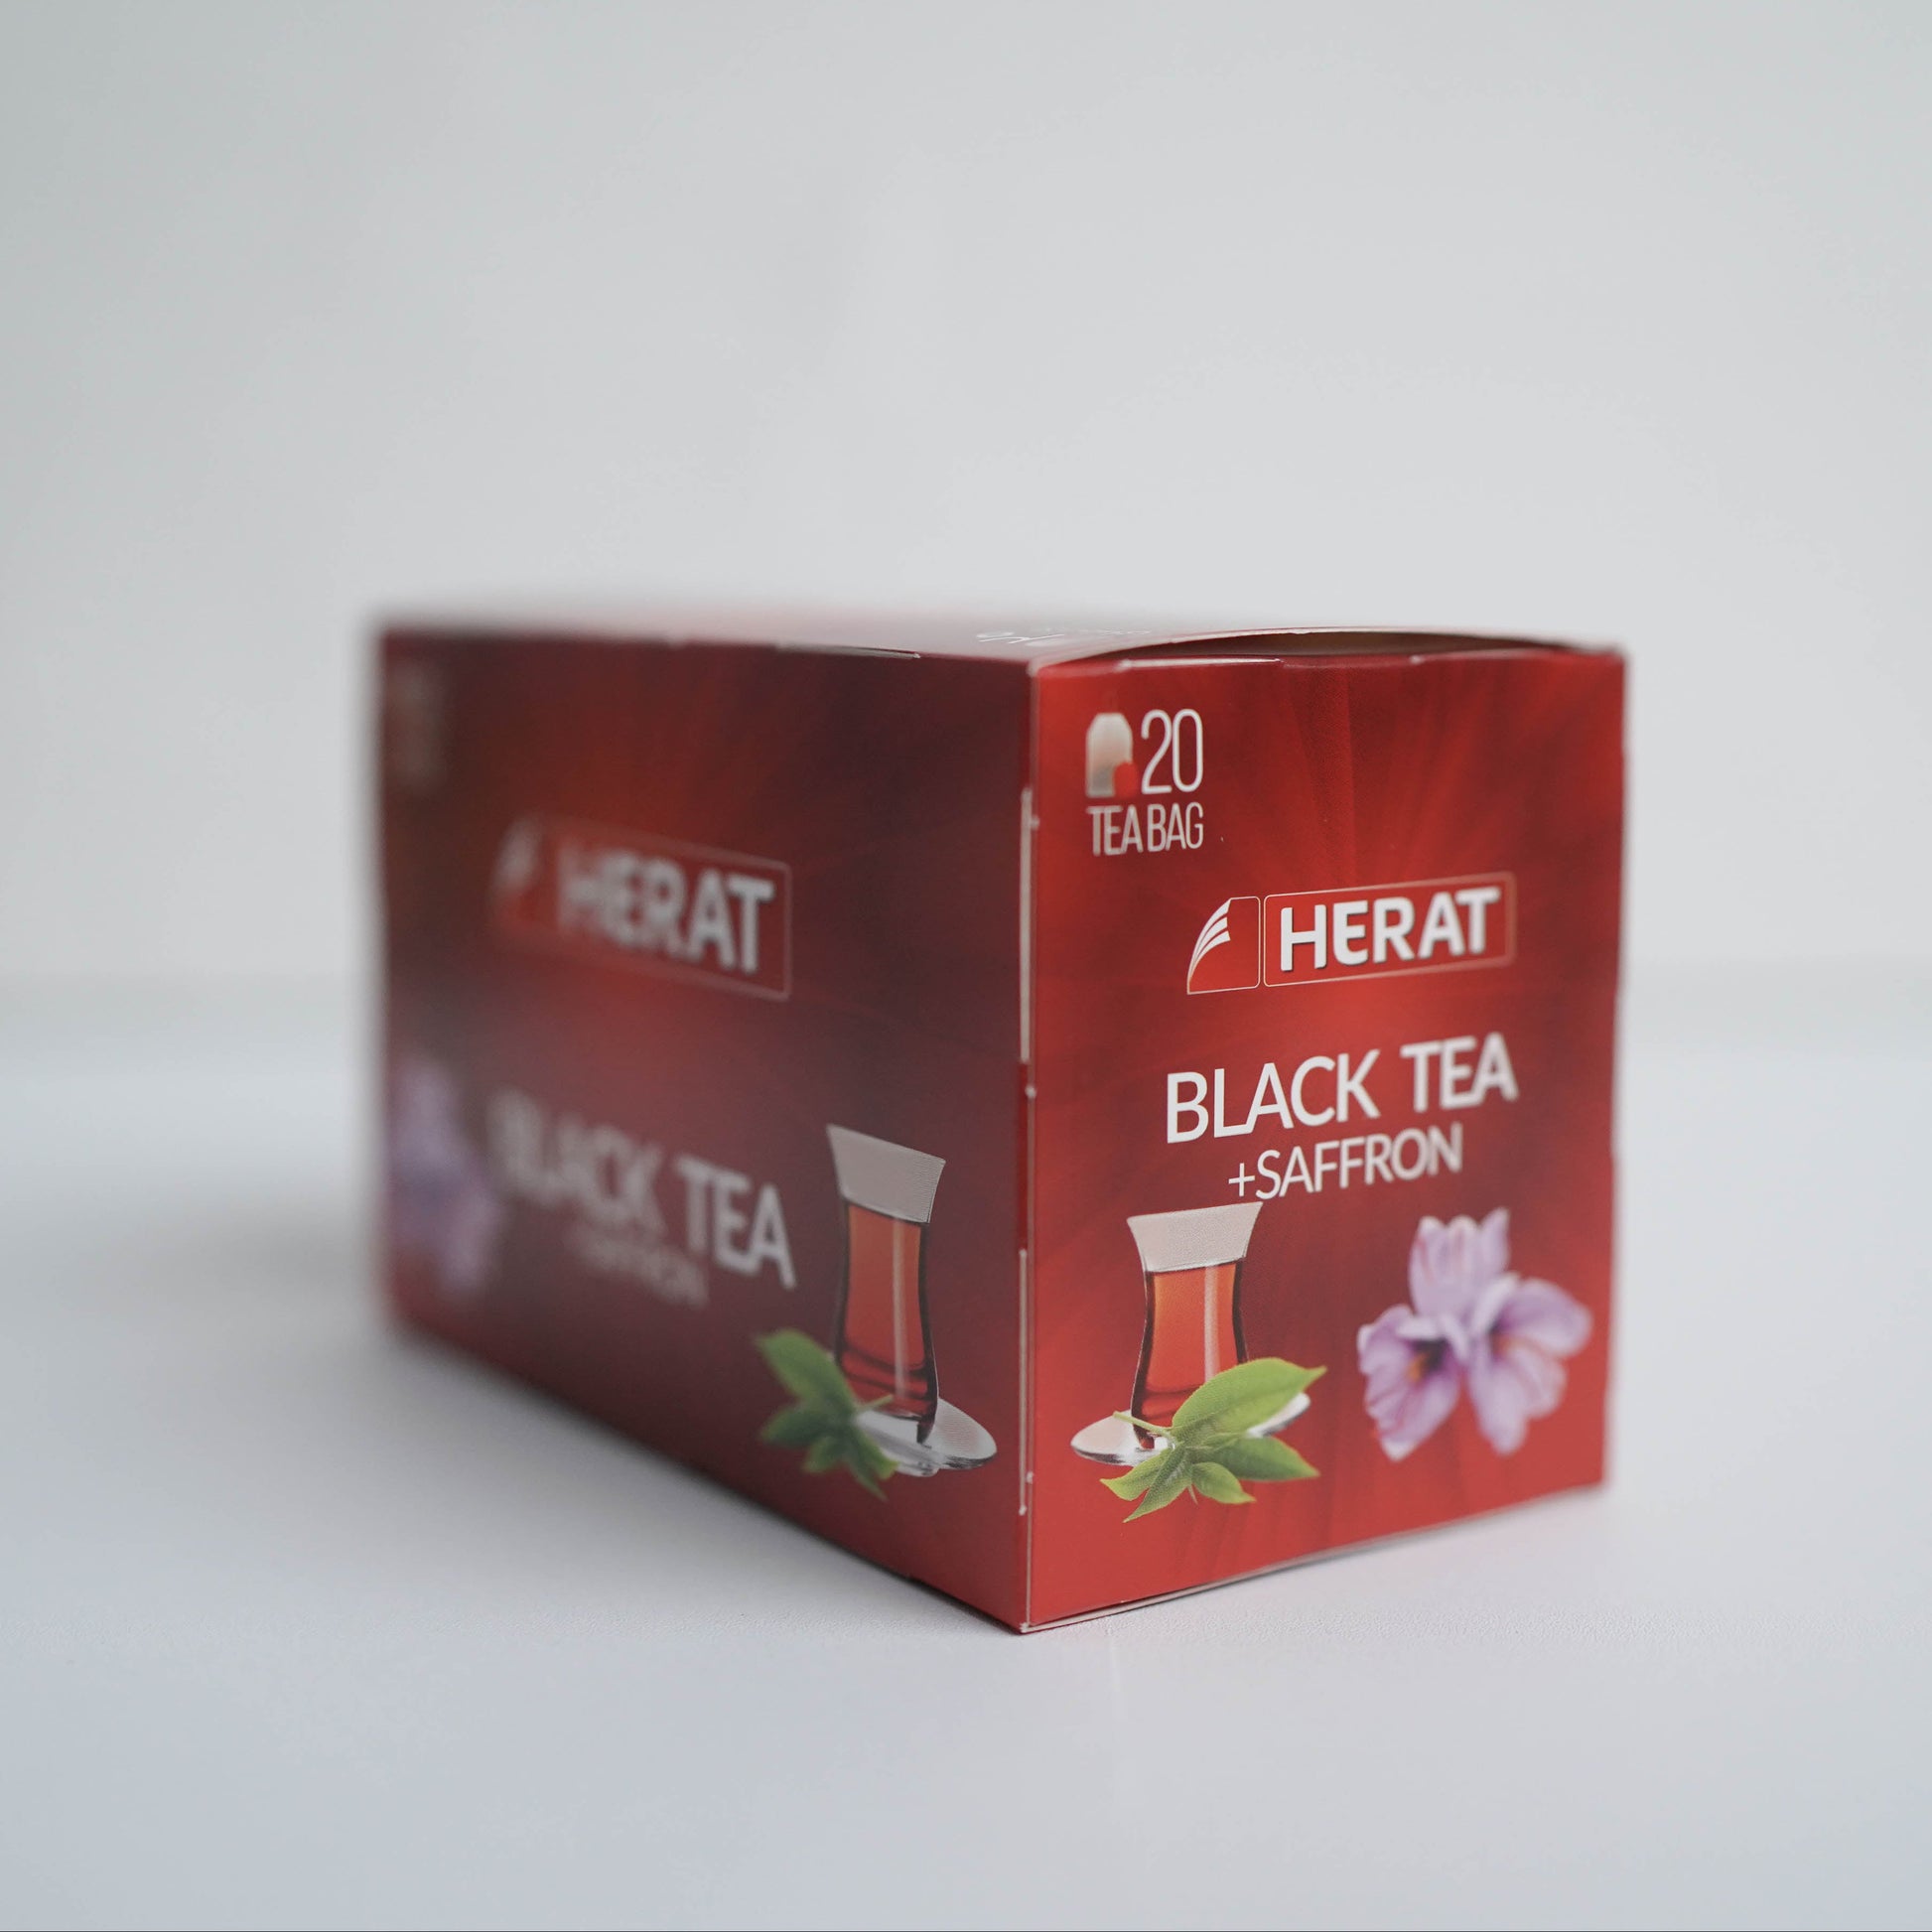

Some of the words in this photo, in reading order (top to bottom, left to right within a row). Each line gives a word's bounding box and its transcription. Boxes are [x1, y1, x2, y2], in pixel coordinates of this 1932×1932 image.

[1141, 709, 1204, 794] 20
[1086, 804, 1143, 857] TEA
[1147, 801, 1204, 853] BAG
[559, 840, 775, 975] HERAT
[1279, 887, 1501, 973] HERAT
[1167, 1047, 1382, 1145] BLACK
[1400, 1032, 1519, 1114] TEA
[1228, 1121, 1463, 1200] +SAFFRON
[675, 1154, 795, 1290] TEA
